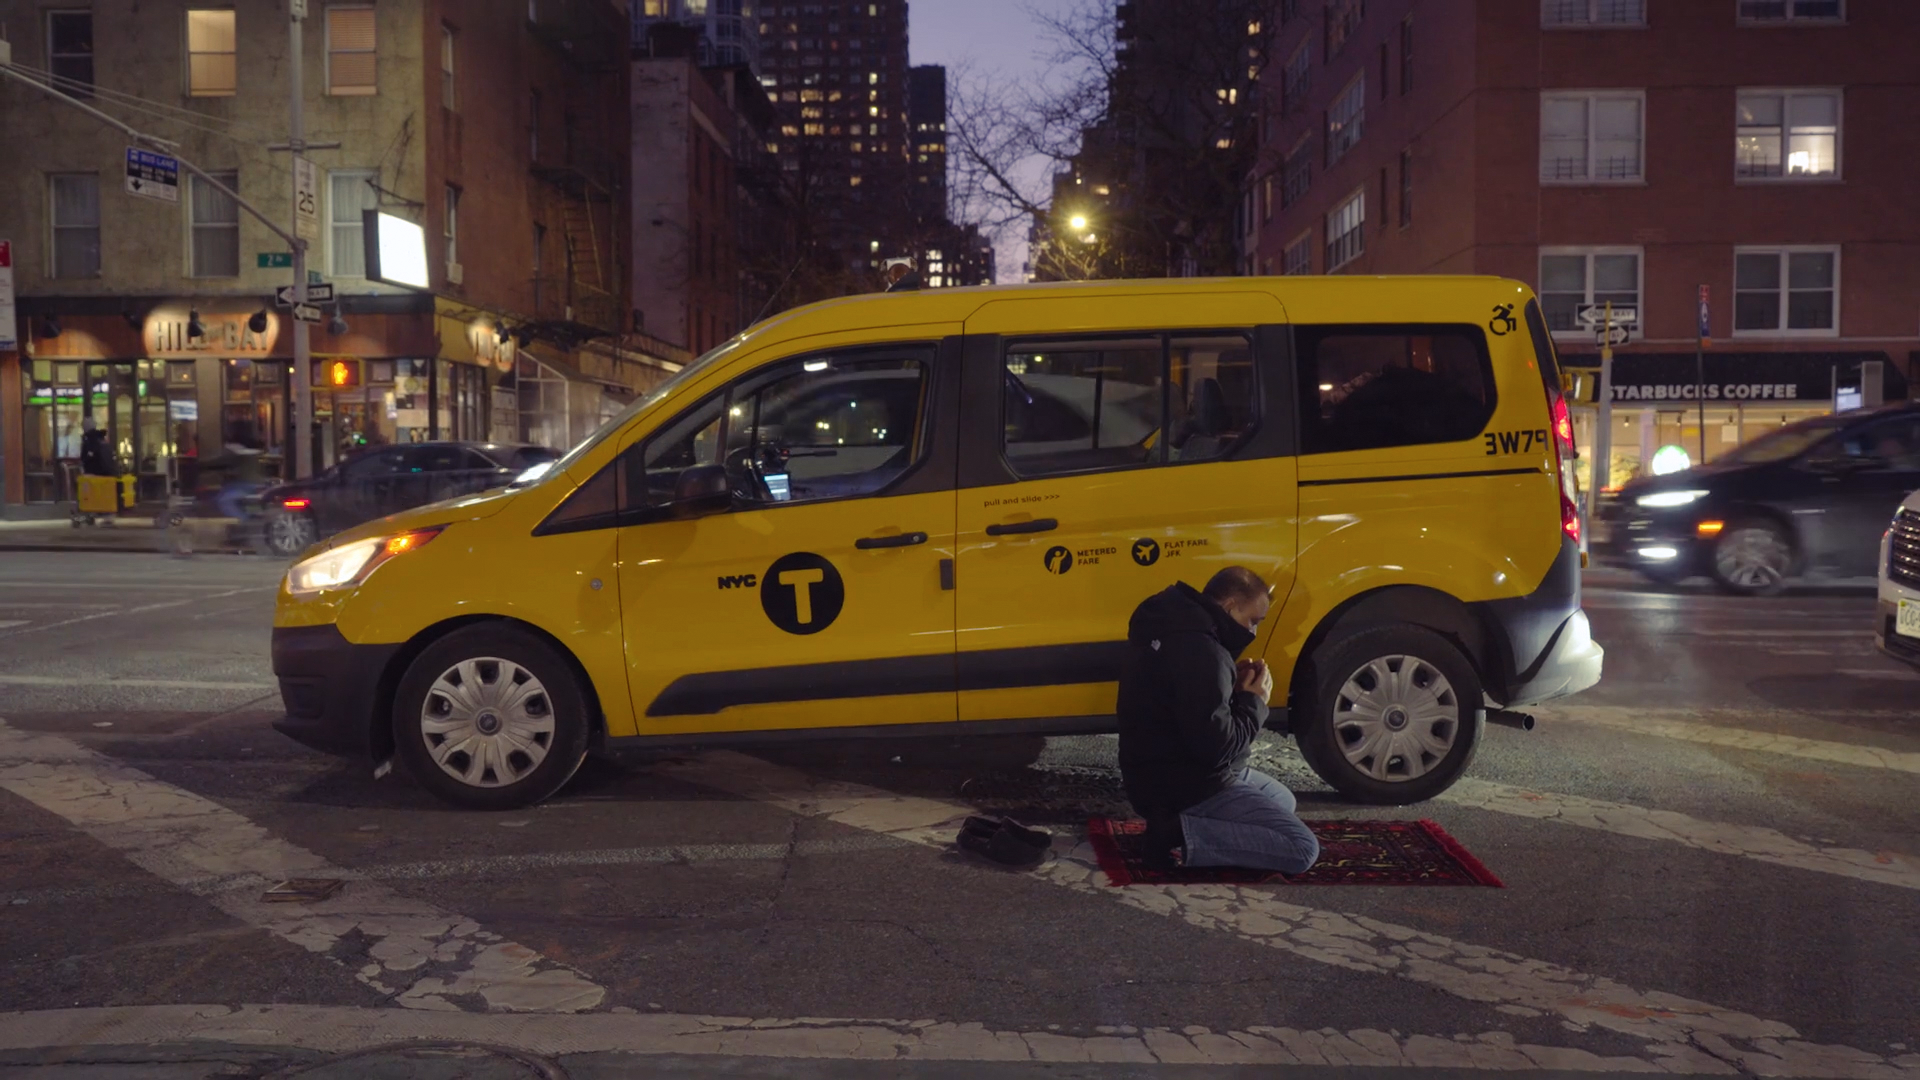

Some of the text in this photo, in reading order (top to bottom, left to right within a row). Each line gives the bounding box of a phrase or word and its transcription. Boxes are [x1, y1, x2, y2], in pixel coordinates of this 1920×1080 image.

[156, 157, 175, 169] LANE
[299, 191, 314, 214] 25
[267, 255, 273, 266] 2
[308, 289, 325, 298] WAY
[1588, 309, 1631, 317] ONE WAY
[1723, 383, 1797, 399] COFFEE
[1484, 429, 1549, 456] 3W79
[983, 499, 1000, 508] pull
[1002, 497, 1019, 505] and
[1021, 495, 1042, 503] slide
[1164, 538, 1209, 549] FLAT FARE
[1077, 547, 1117, 557] METERED
[1165, 550, 1181, 558] JFK
[1078, 557, 1100, 566] FARE
[717, 574, 757, 590] NYC
[778, 568, 824, 625] T
